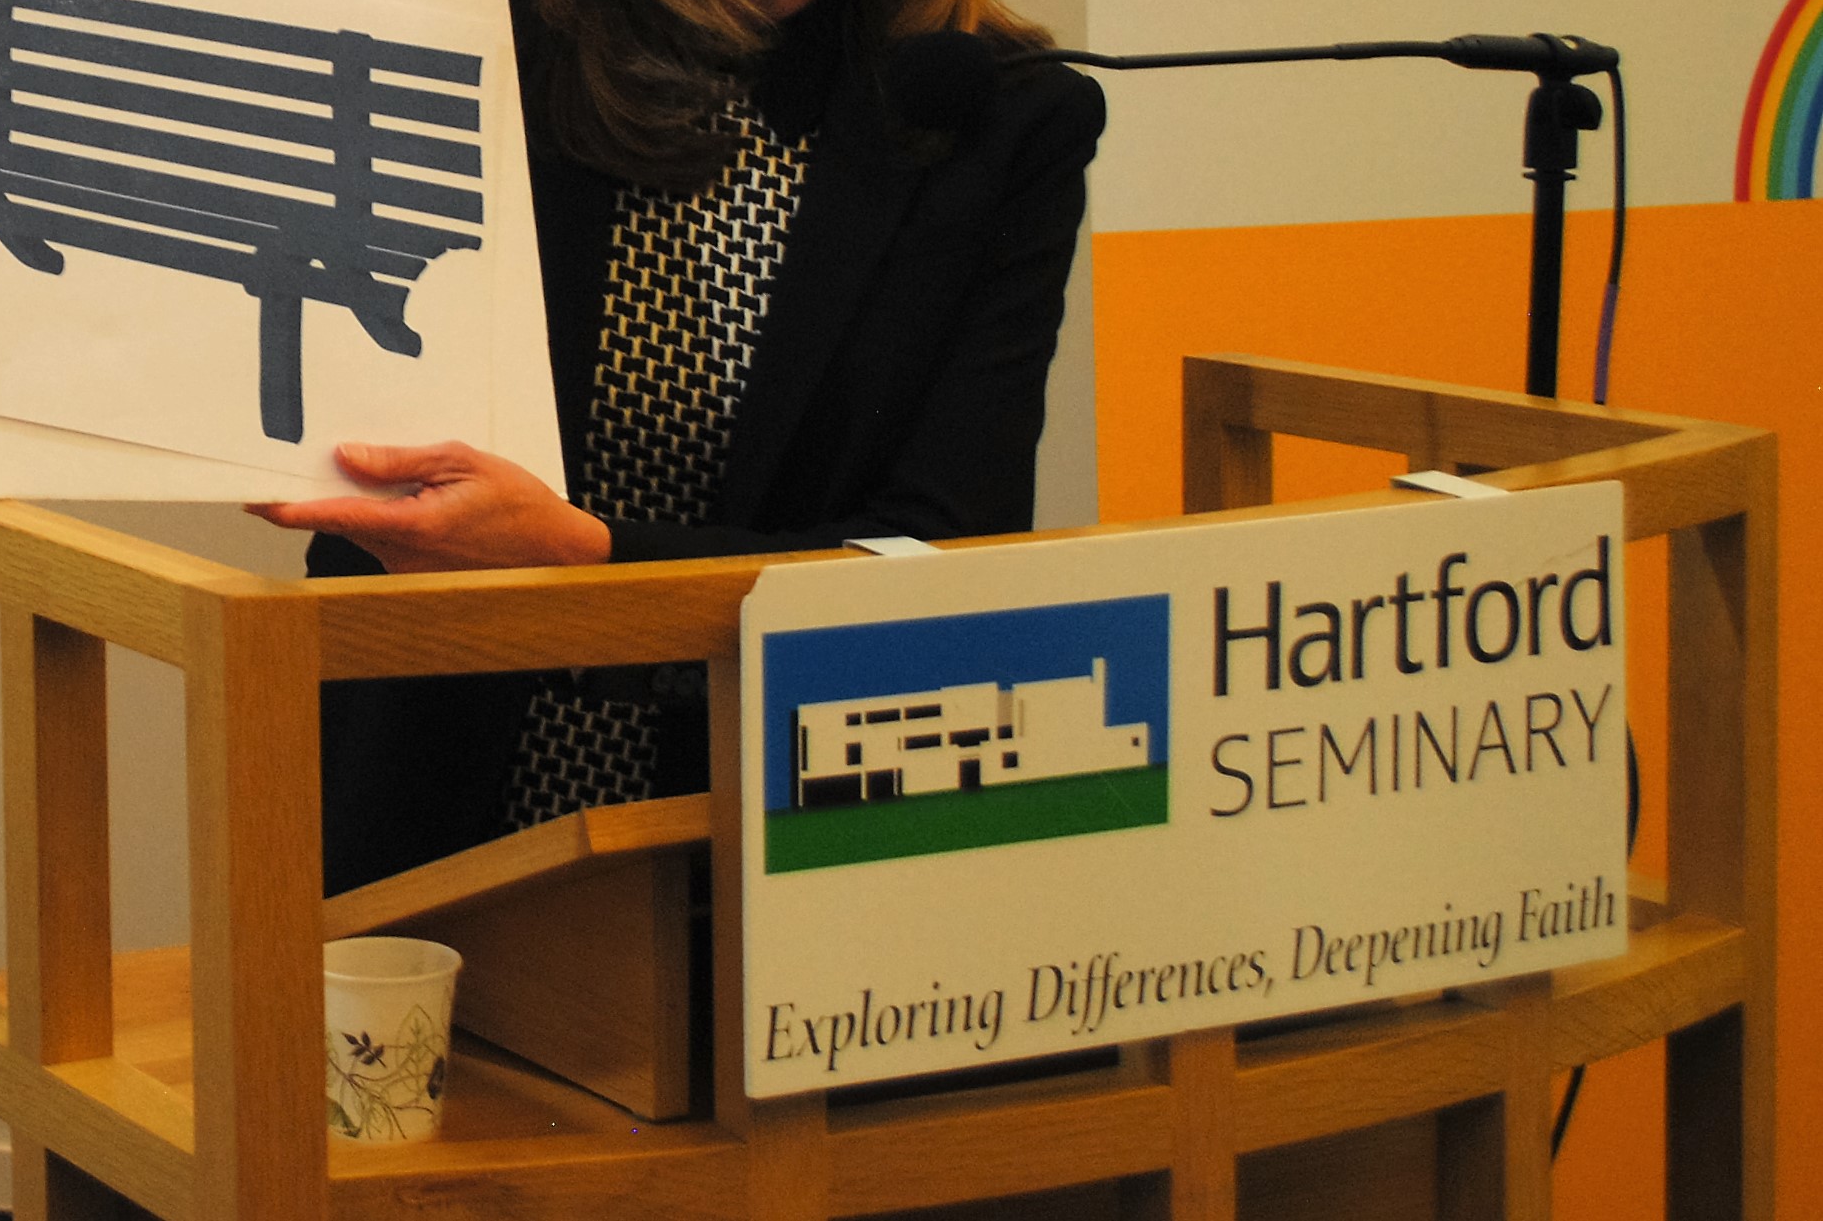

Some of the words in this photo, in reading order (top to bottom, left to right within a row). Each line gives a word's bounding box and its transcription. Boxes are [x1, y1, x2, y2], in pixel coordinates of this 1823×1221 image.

[1212, 535, 1614, 697] Hartford
[1209, 684, 1614, 818] SEMINARY
[762, 980, 1004, 1072] Exploring
[1025, 951, 1275, 1036] Differences,
[1291, 902, 1504, 986] Deepening
[1515, 875, 1616, 944] Faith
